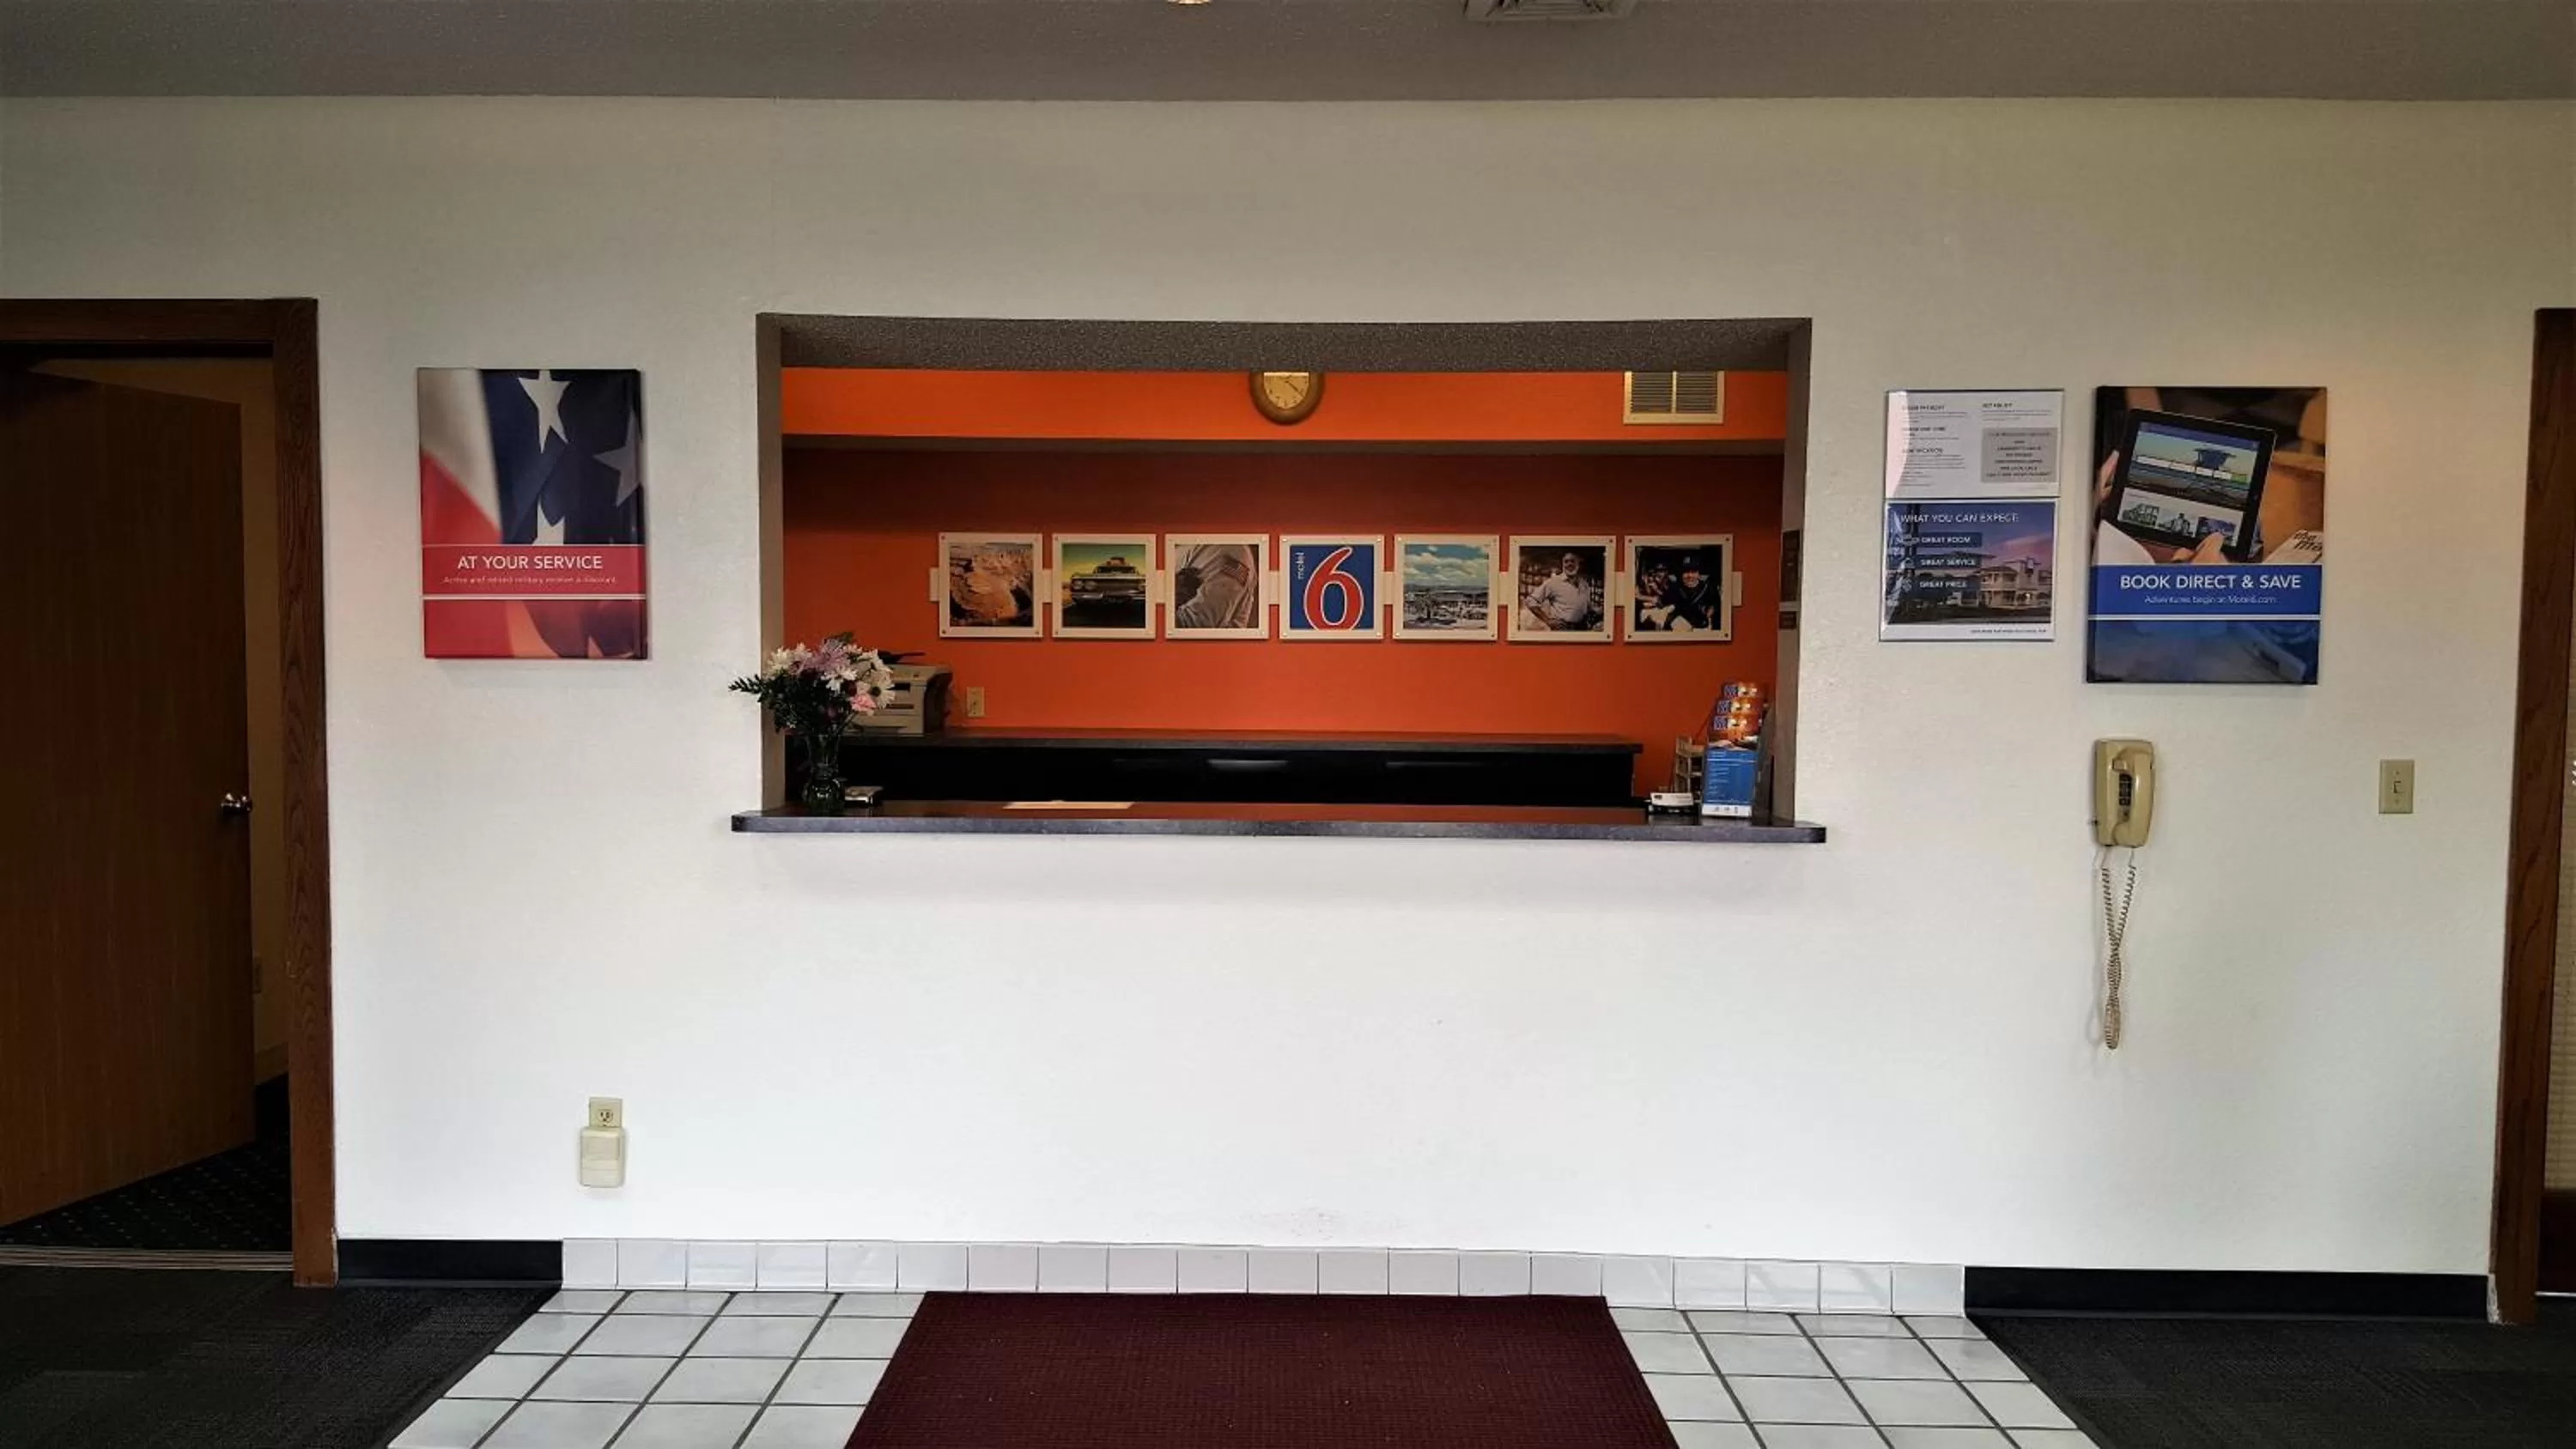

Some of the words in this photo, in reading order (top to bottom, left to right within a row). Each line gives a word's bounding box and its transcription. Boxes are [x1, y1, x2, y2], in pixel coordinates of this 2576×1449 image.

[1900, 514, 1929, 523] WHAT
[1931, 514, 1953, 523] YOU
[1955, 514, 1978, 523] CAN
[457, 555, 477, 569] AT
[482, 555, 529, 569] YOUR
[533, 555, 603, 569] SERVICE
[1303, 547, 1364, 630] 6
[2120, 575, 2171, 589] BOOK
[2176, 575, 2237, 589] DIRECT
[2241, 574, 2254, 589] &
[2259, 575, 2302, 589] SAVE
[2192, 595, 2215, 605] begin
